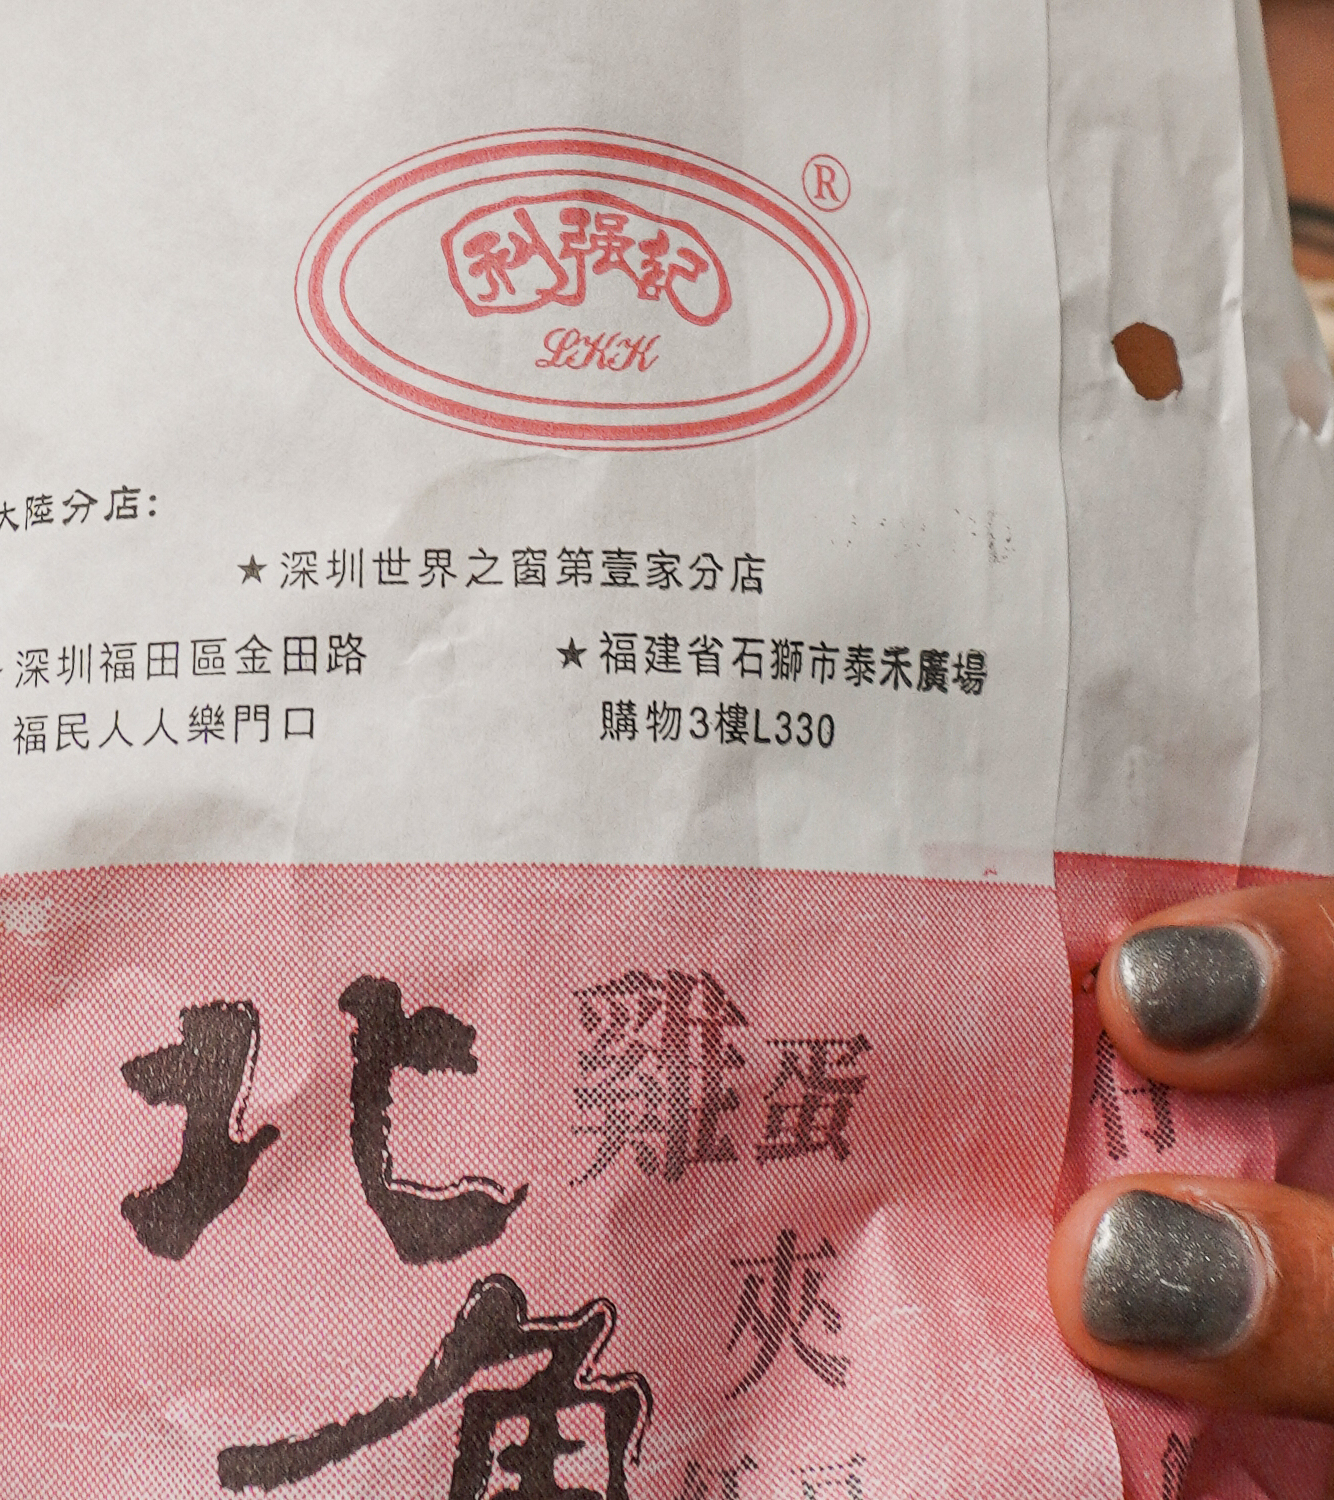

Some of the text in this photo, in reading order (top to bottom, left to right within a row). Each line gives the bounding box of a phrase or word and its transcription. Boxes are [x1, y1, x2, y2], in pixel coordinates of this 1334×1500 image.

[534, 326, 661, 374] LKK
[279, 546, 767, 595] 深圳世界之窗第壹家分店
[14, 633, 368, 690] 深圳福田區金田路
[12, 703, 316, 756] 福民人人樂門口
